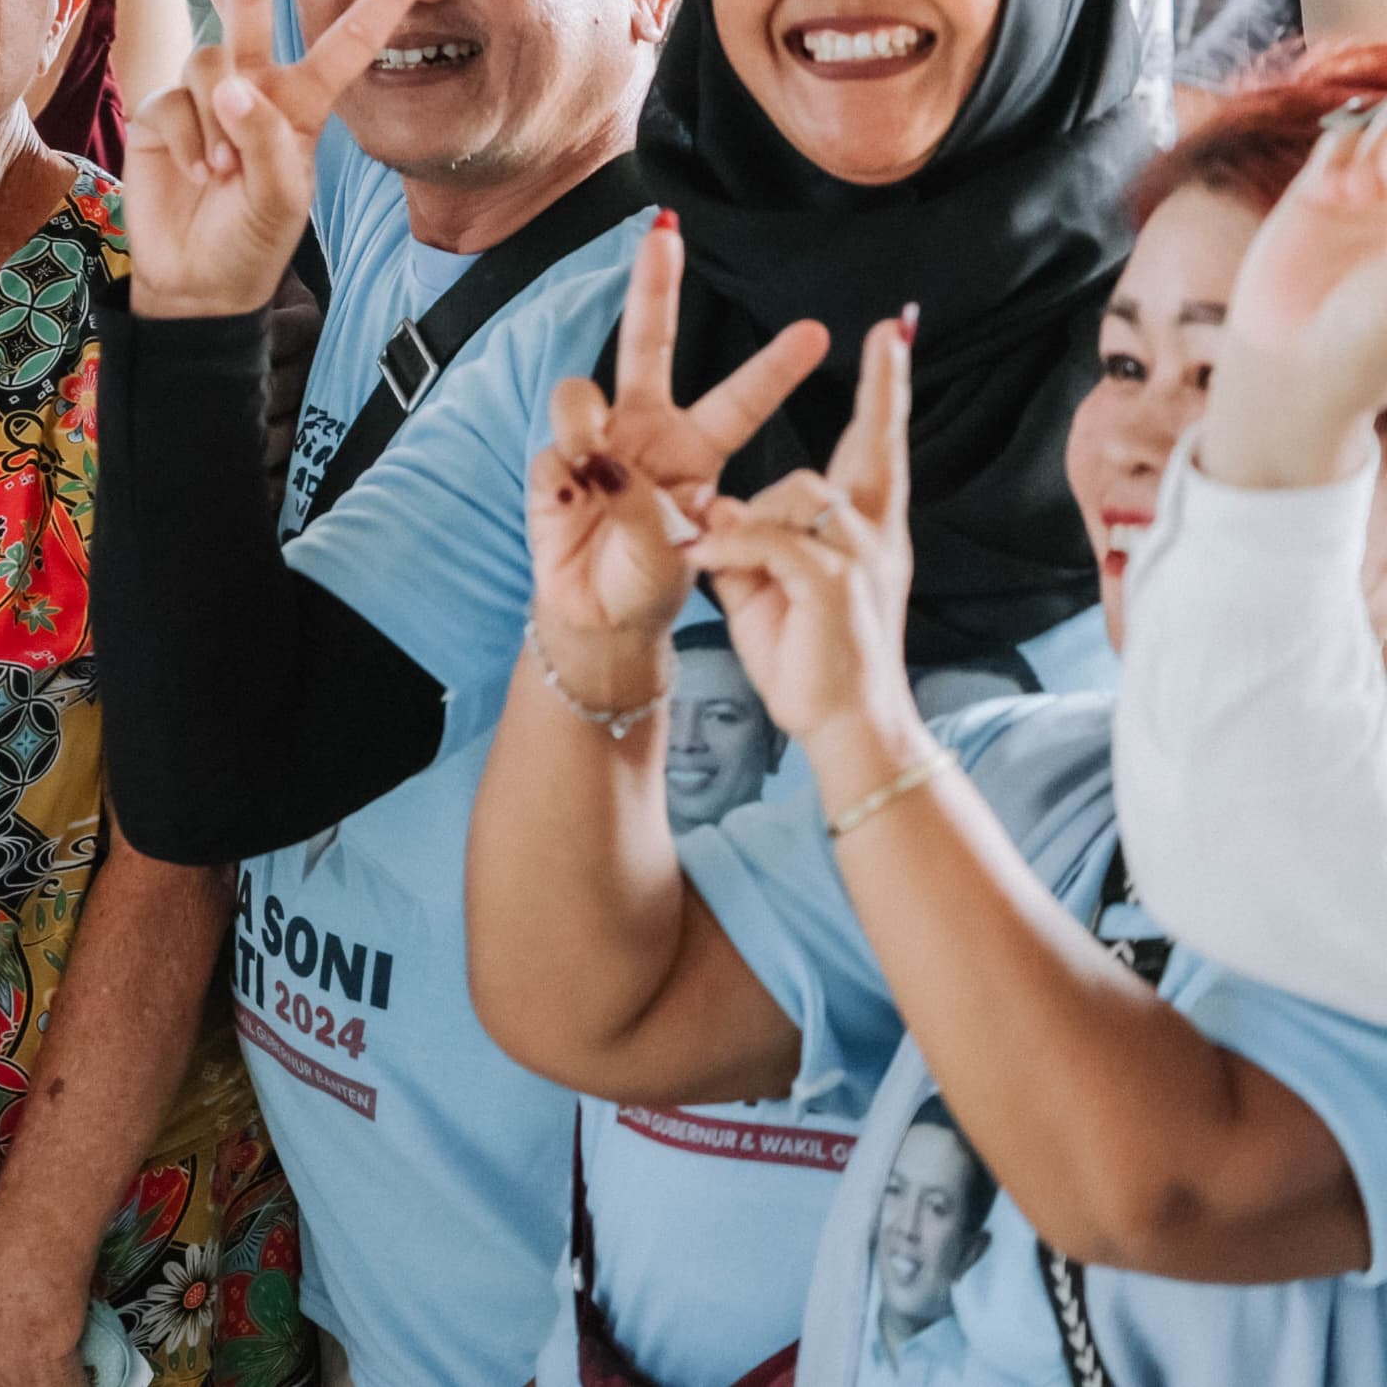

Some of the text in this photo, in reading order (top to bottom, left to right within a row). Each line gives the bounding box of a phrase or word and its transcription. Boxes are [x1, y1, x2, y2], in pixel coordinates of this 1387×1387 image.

[261, 895, 393, 1011] SONI
[274, 980, 367, 1061] 2024
[650, 1115, 738, 1150] GUBERNUR
[740, 1130, 755, 1152] &
[760, 1133, 826, 1160] WAKIL
